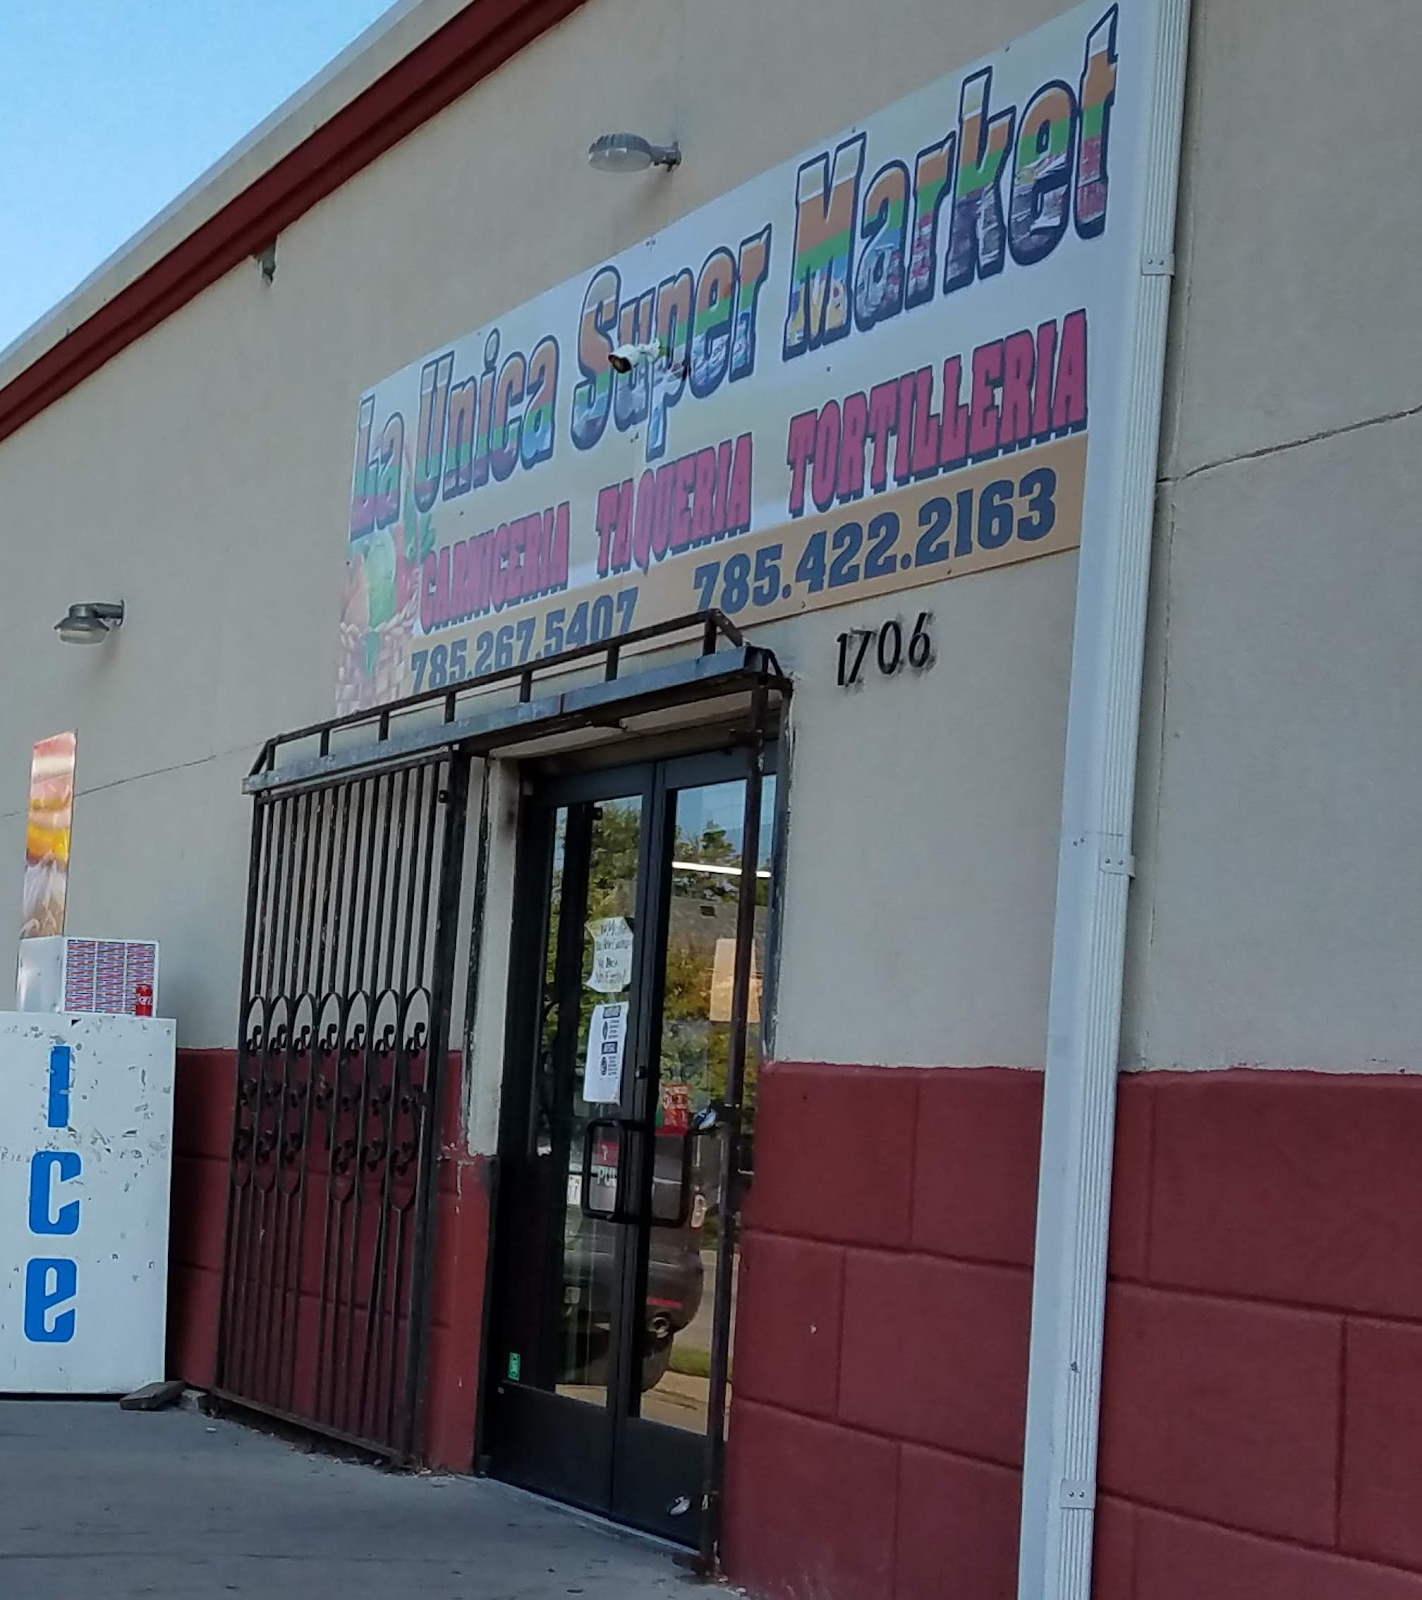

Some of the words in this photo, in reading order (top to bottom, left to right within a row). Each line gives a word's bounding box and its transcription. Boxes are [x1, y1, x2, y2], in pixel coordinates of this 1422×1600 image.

[350, 394, 406, 542] La
[414, 328, 560, 514] Unica
[570, 222, 773, 463] Super
[782, 3, 1119, 362] Market
[411, 586, 640, 695] 785.267.5407
[693, 467, 1057, 614] 785.422.2163
[420, 501, 570, 635] CARNICERIA
[596, 432, 752, 579] TAQUERIA
[787, 308, 1087, 518] TORTILLERIA
[836, 611, 934, 686] 1706
